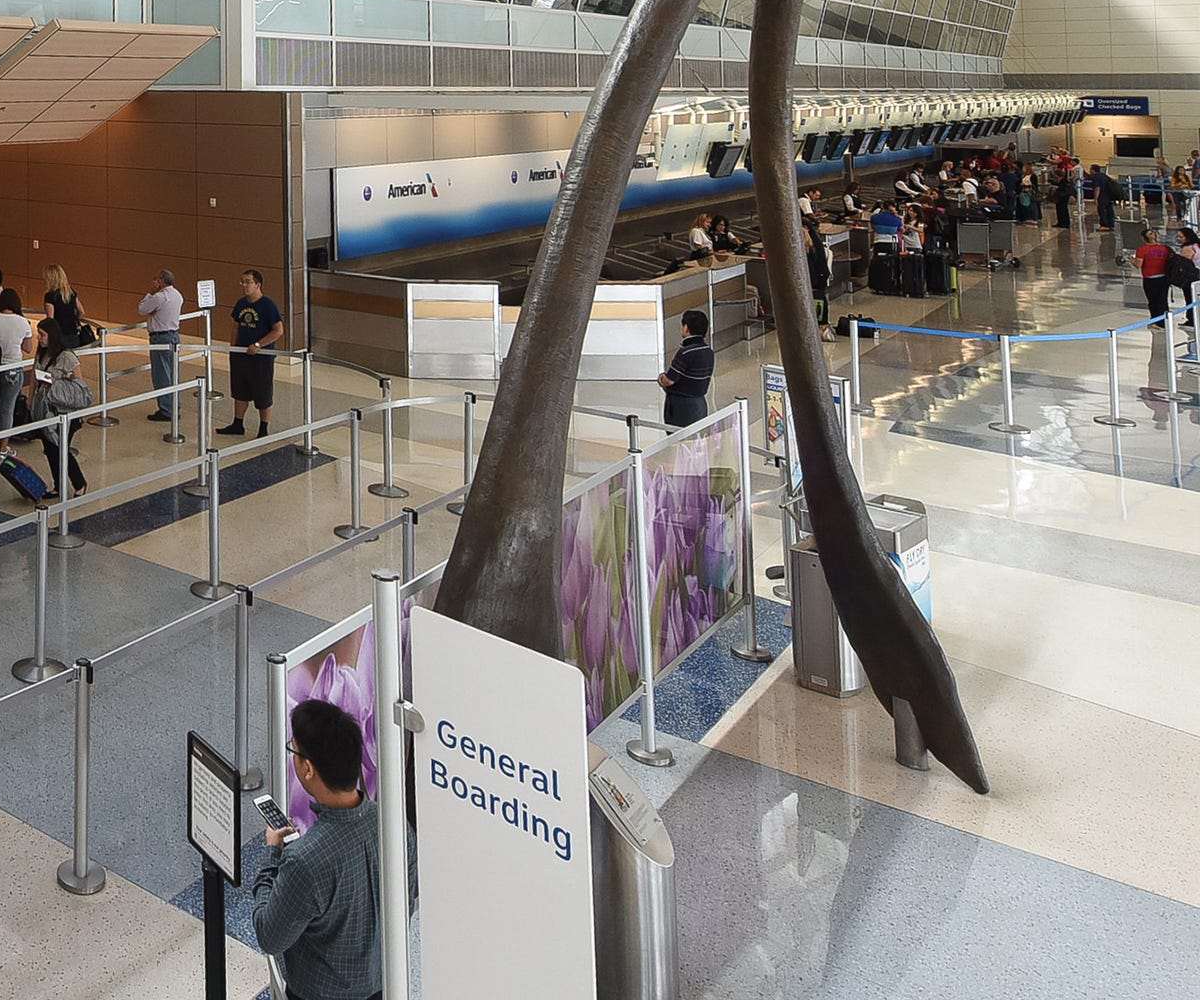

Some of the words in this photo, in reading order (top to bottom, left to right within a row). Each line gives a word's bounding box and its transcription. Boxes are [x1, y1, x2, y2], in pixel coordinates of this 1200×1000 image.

[388, 182, 426, 198] American
[529, 168, 557, 182] American
[437, 720, 561, 801] General
[431, 758, 571, 861] Boarding
